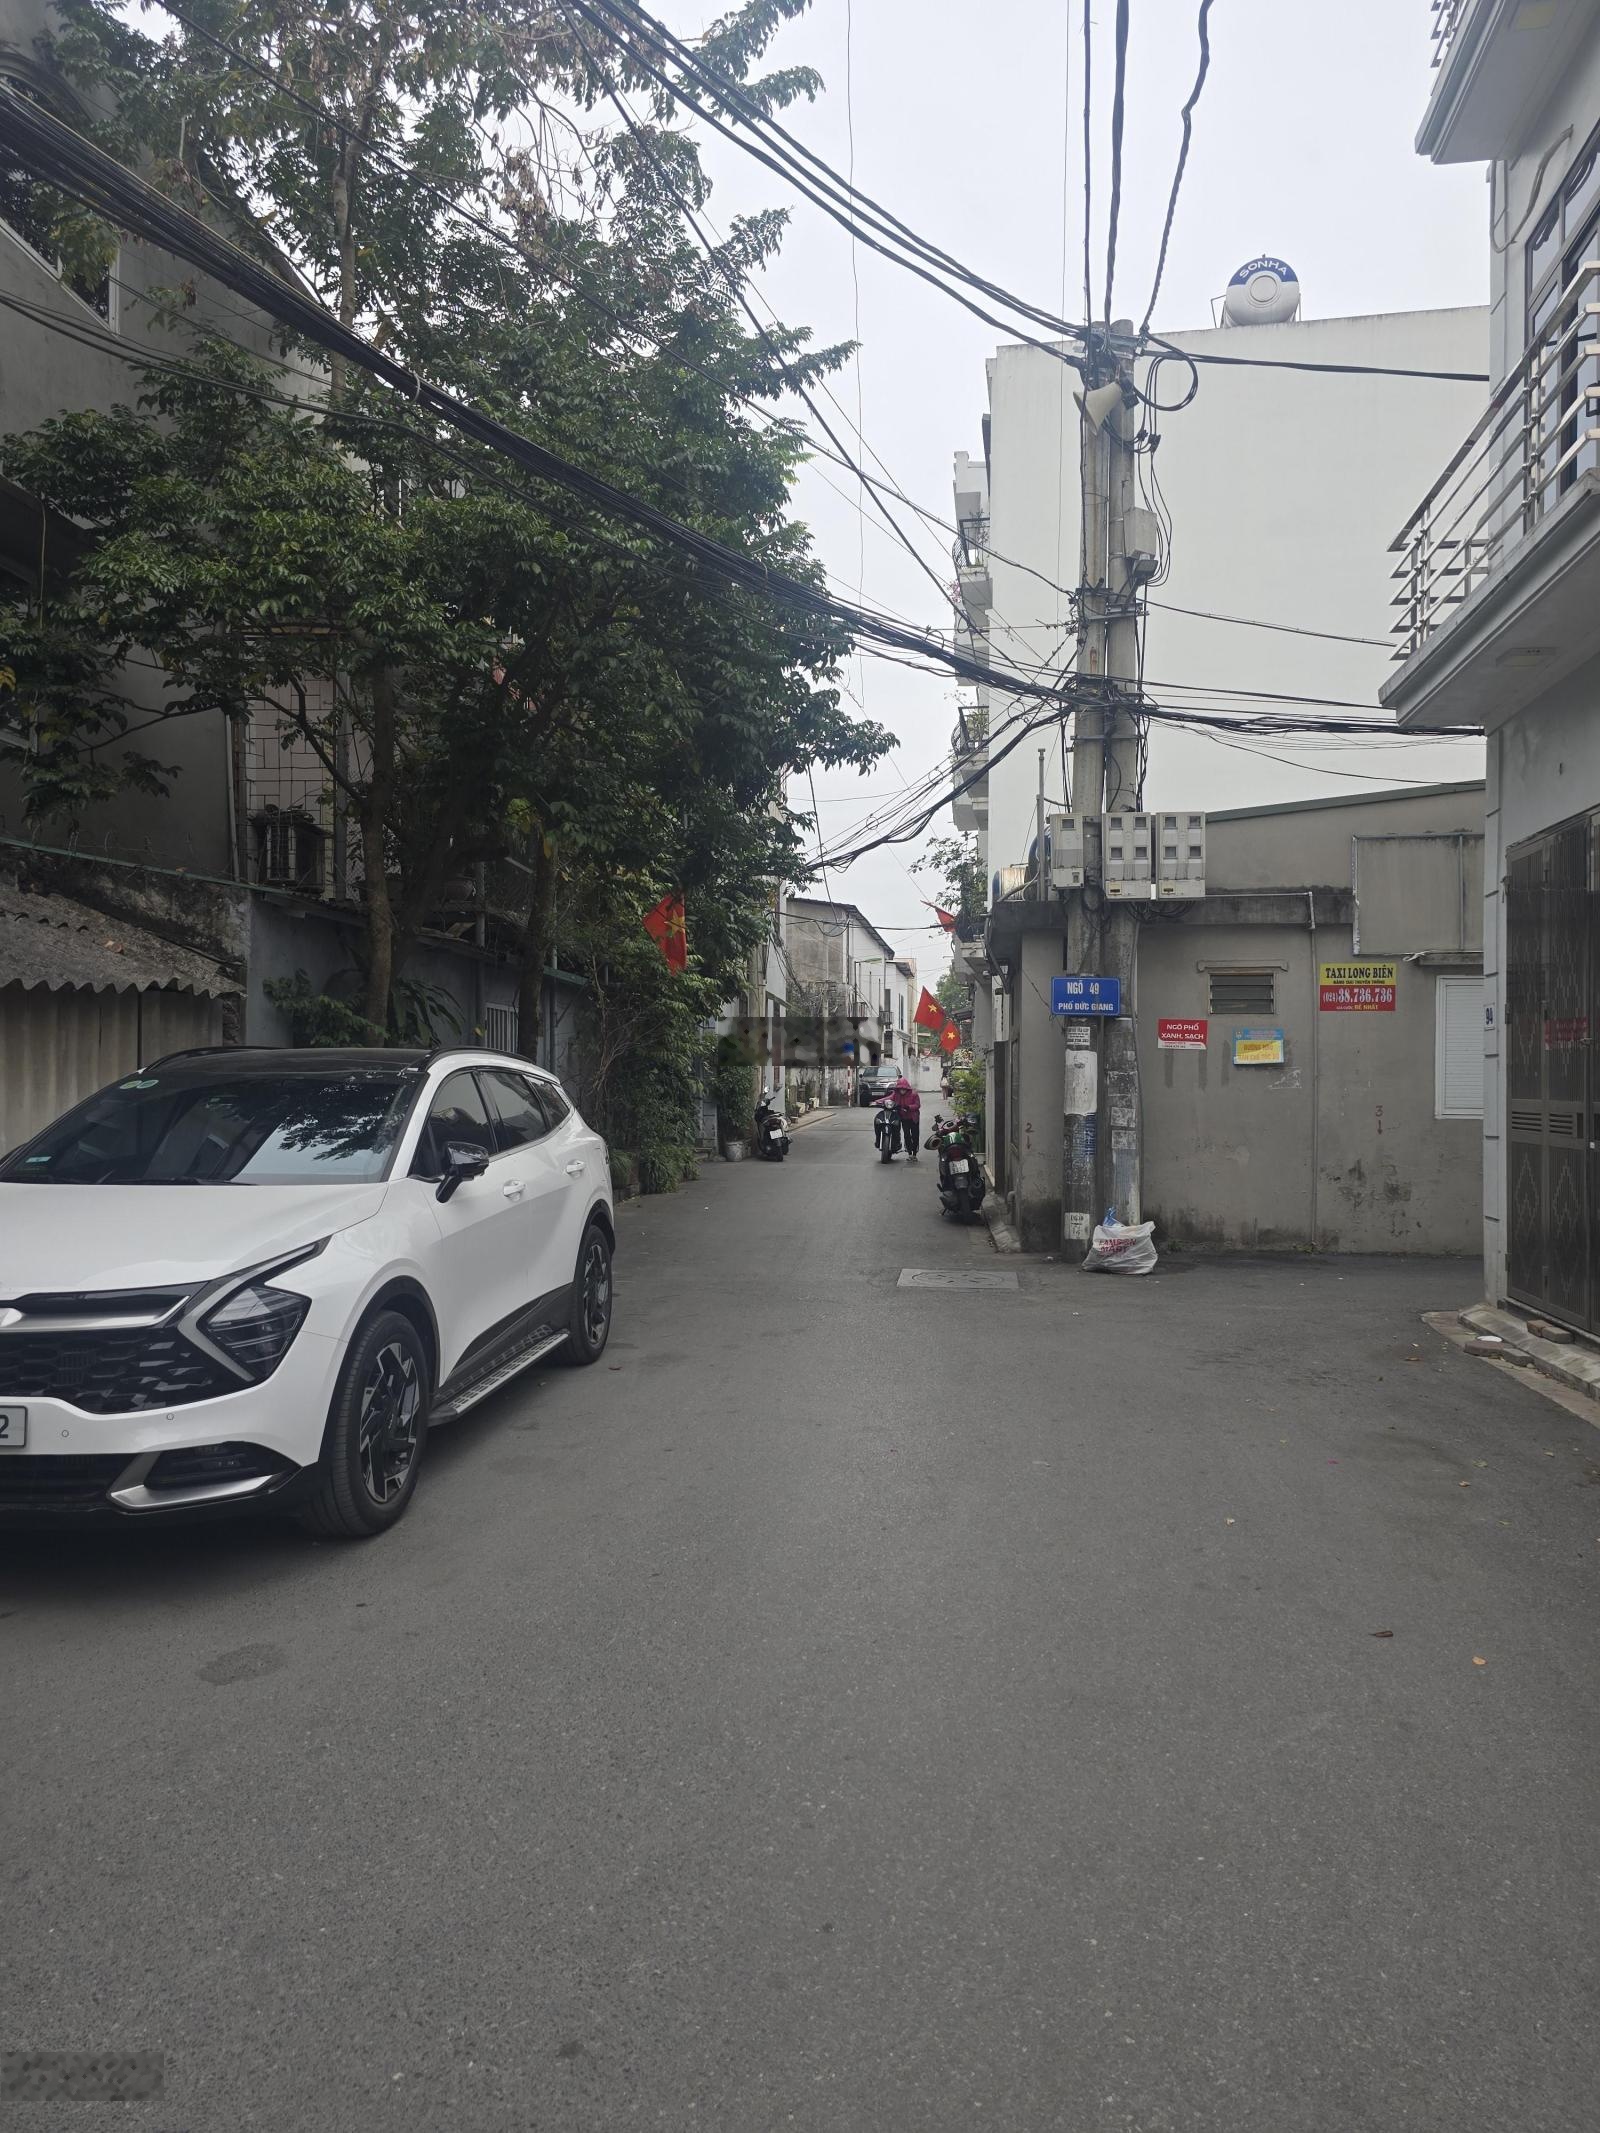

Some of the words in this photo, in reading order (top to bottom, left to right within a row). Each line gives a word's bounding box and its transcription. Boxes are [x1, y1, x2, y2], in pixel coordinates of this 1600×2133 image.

[1239, 260, 1287, 278] SONHA
[1326, 967, 1346, 978] TAXI
[1348, 967, 1370, 978] LONG
[1373, 965, 1393, 978] BIÊN
[1067, 980, 1084, 995] NGÕ
[1089, 982, 1100, 995] 49
[1058, 1000, 1074, 1011] PHỐ
[1074, 1001, 1090, 1011] ĐỨC
[1091, 1003, 1114, 1011] GIANG
[1485, 1007, 1494, 1025] 94
[1183, 1022, 1200, 1031] PHỐ
[1184, 1033, 1204, 1041] SẠCH
